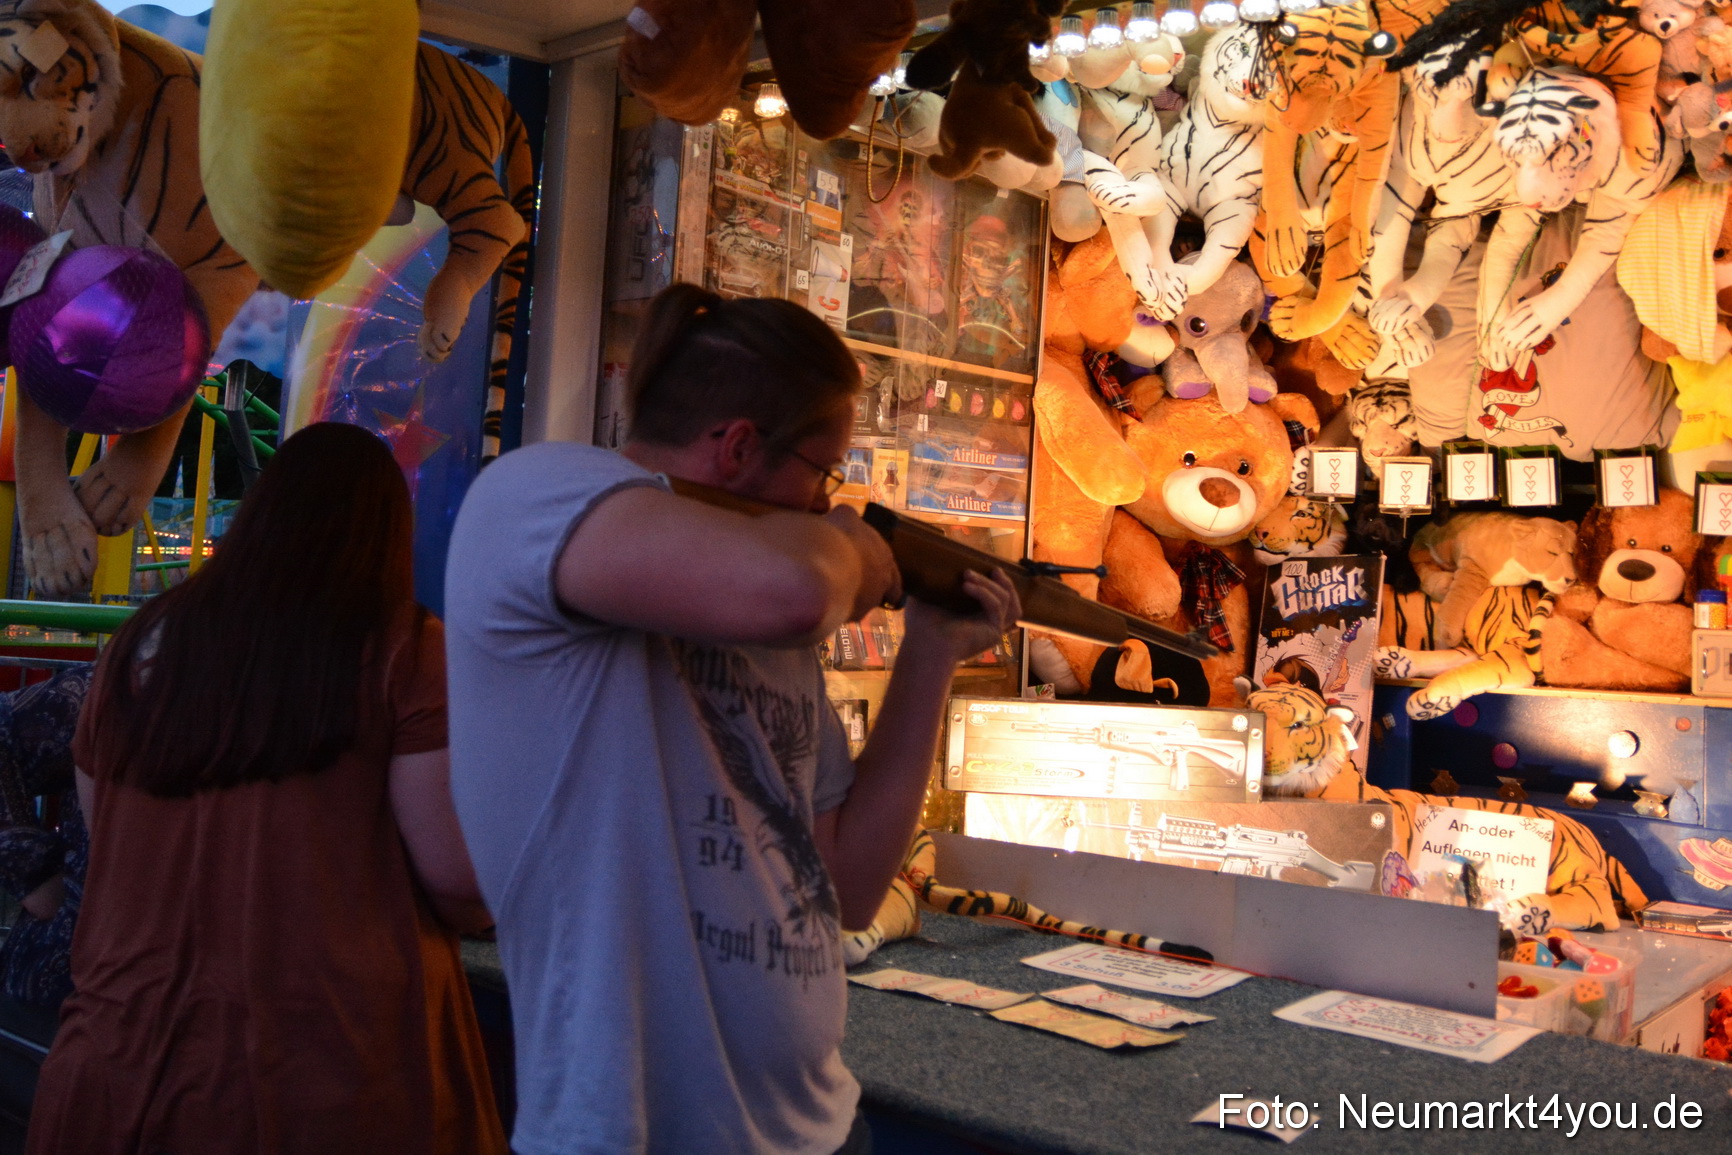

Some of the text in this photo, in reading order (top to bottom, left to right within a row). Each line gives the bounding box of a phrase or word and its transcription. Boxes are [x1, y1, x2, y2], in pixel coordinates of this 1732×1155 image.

[818, 173, 838, 191] 55
[842, 238, 851, 248] 60
[797, 274, 807, 285] 65
[936, 383, 945, 395] 30
[1486, 391, 1535, 405] LOVE
[1508, 417, 1555, 432] KILLS
[952, 447, 998, 466] Airliner
[946, 494, 993, 513] Airliner
[1284, 563, 1303, 575] 100
[1299, 564, 1345, 591] ROCK
[1270, 566, 1370, 620] GUITAR
[1034, 768, 1074, 778] Storm
[1414, 809, 1438, 834] Herz
[1448, 819, 1516, 839] An- oder
[1496, 853, 1537, 869] nicht
